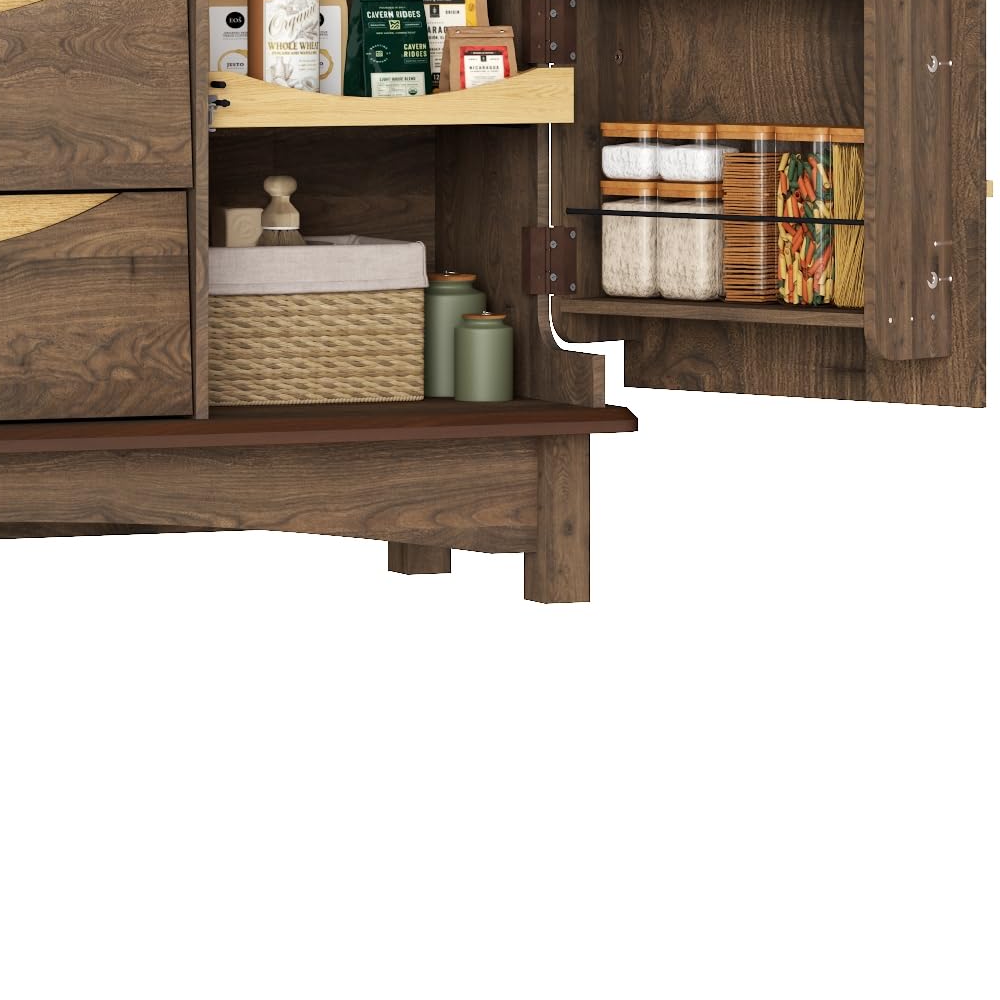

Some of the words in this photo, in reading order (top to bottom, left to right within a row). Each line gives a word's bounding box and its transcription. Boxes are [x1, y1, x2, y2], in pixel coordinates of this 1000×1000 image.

[366, 10, 394, 19] CAVERN
[395, 10, 421, 18] RIDGES
[268, 41, 298, 50] WHOLE
[403, 50, 428, 58] RIDGES
